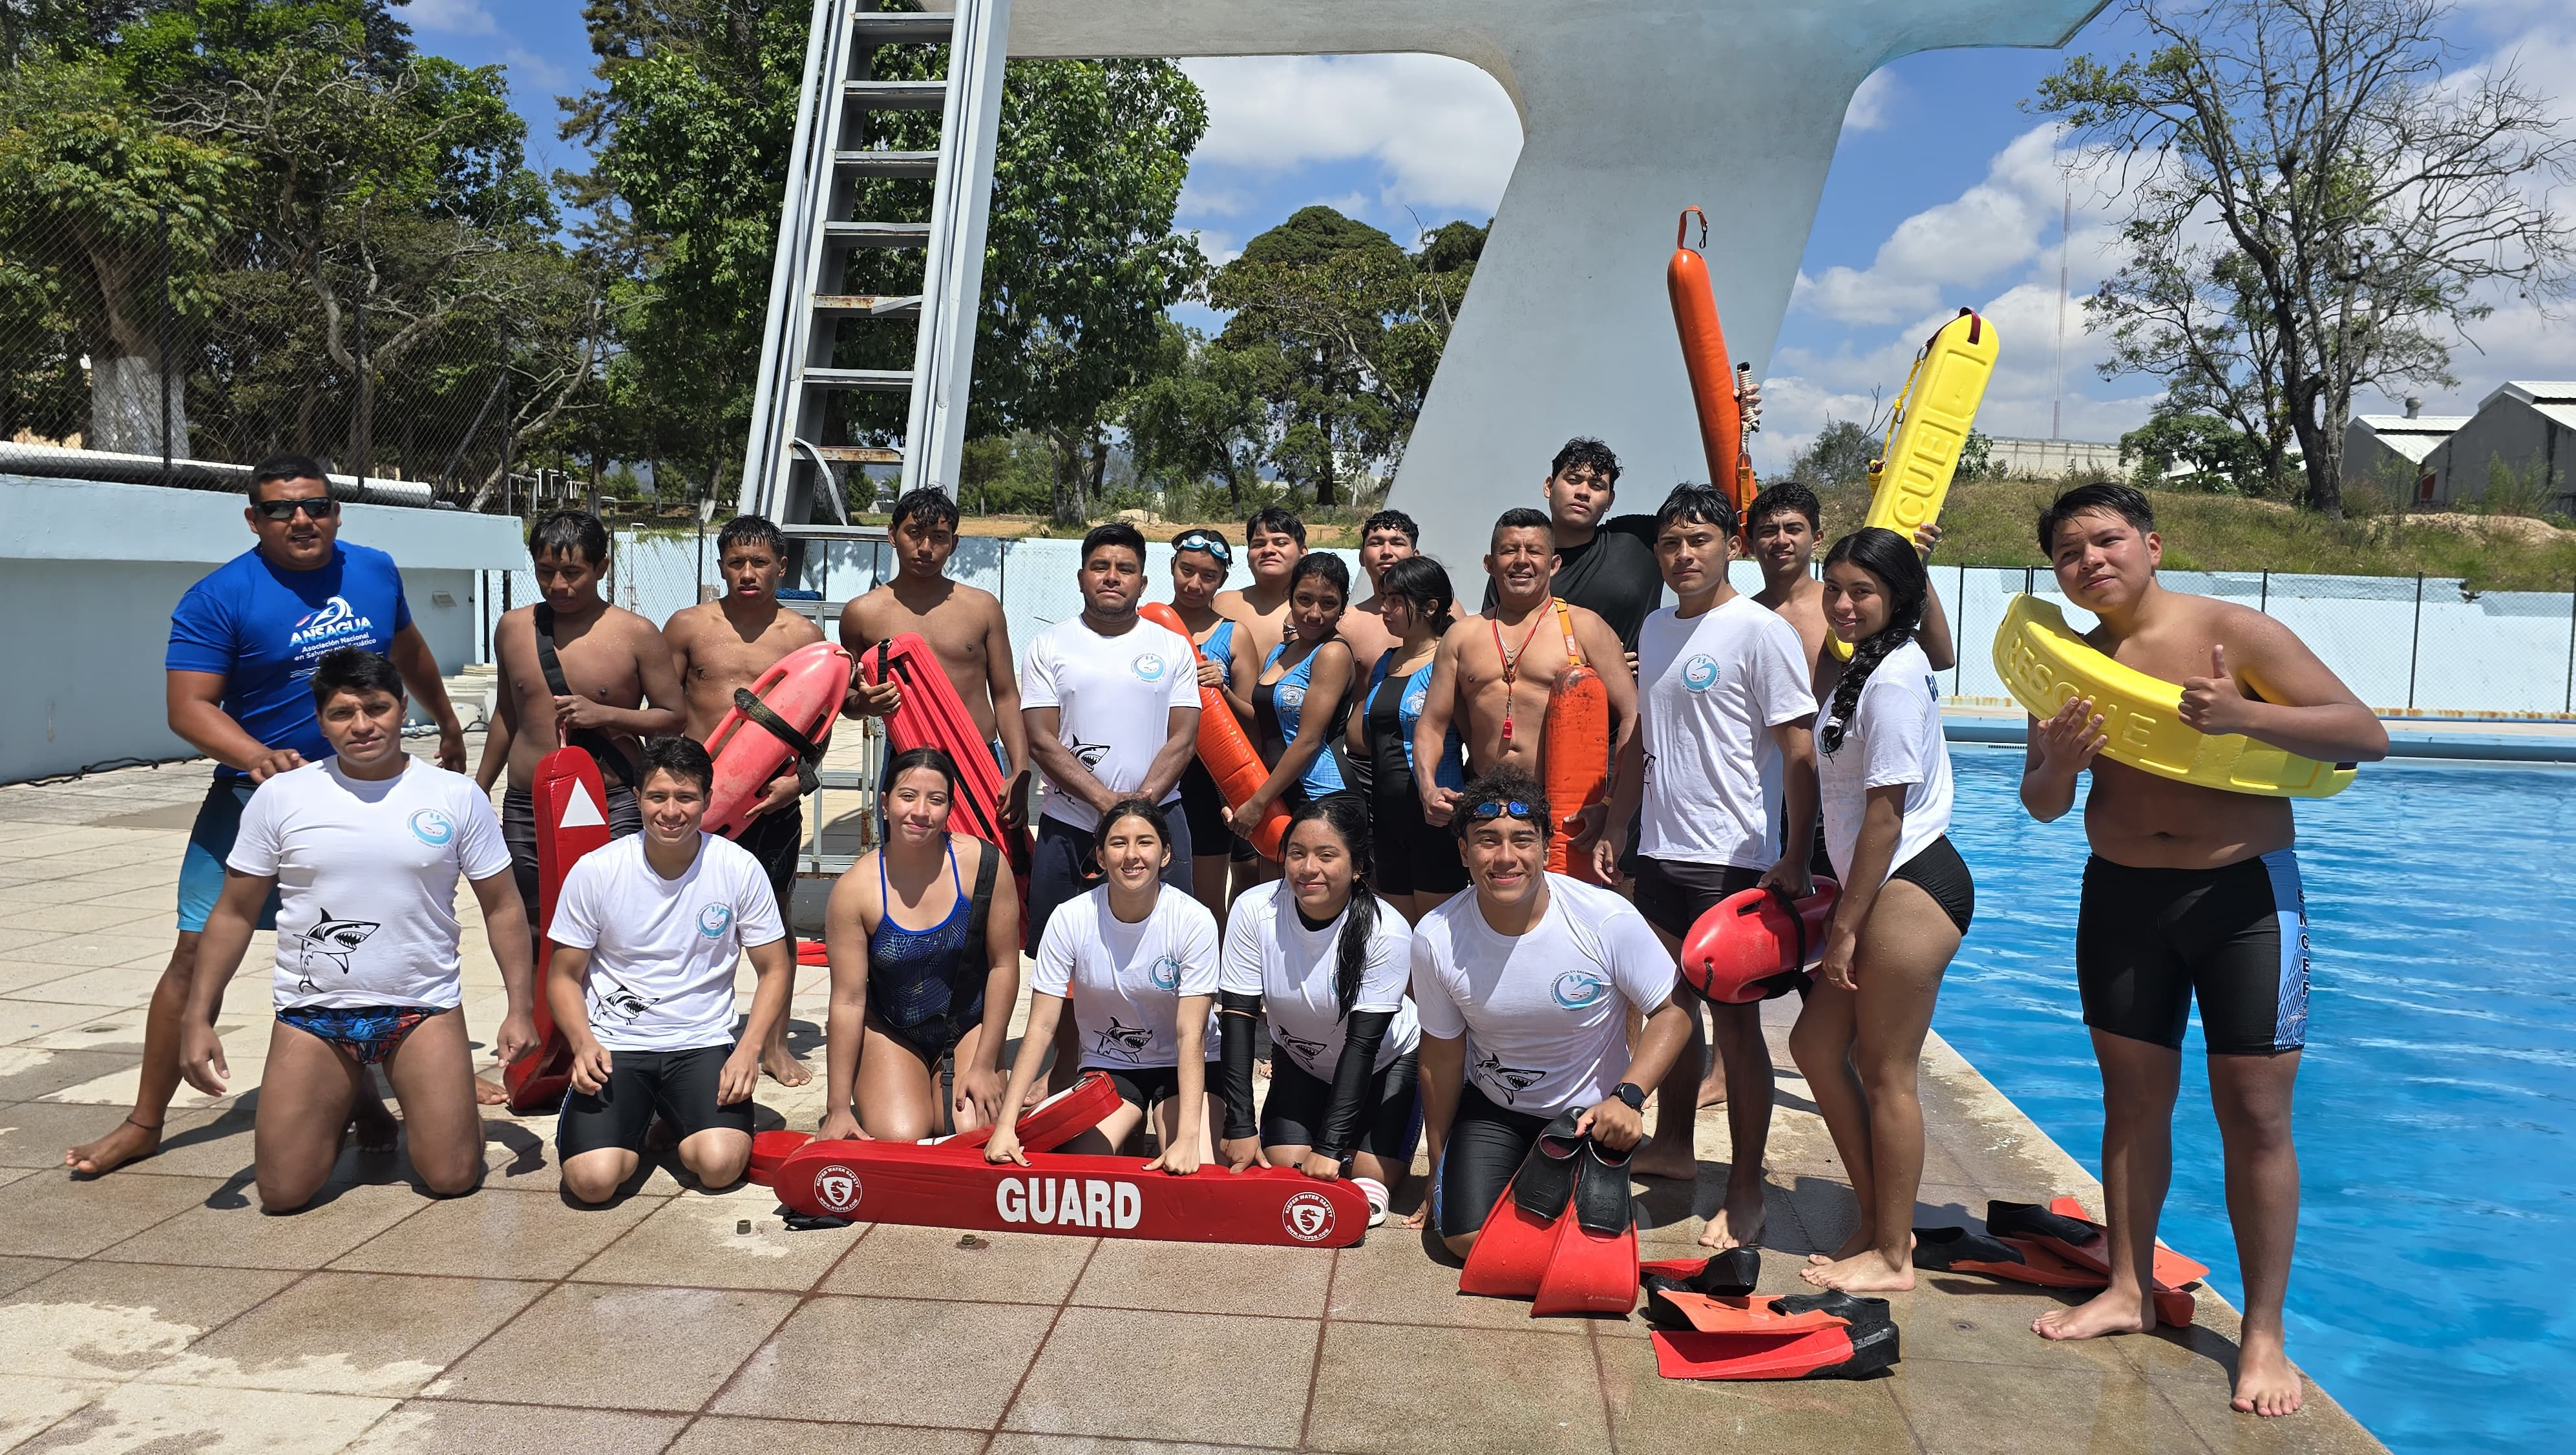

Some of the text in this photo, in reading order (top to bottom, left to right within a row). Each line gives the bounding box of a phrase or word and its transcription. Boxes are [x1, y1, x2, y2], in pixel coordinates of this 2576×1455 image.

[289, 616, 374, 647] ANSAGUA
[301, 631, 370, 653] Asociación Nacional
[348, 638, 377, 648] cuático
[816, 1170, 828, 1187] KIEFER
[845, 1170, 860, 1188] SAFETY
[819, 1196, 858, 1211] WWW.KIEFER.COM
[996, 1177, 1141, 1230] GUARD
[1285, 1197, 1299, 1214] KIEFER
[1319, 1199, 1333, 1217] SAFETY
[1287, 1224, 1329, 1240] WWW.KIEFER.COM
